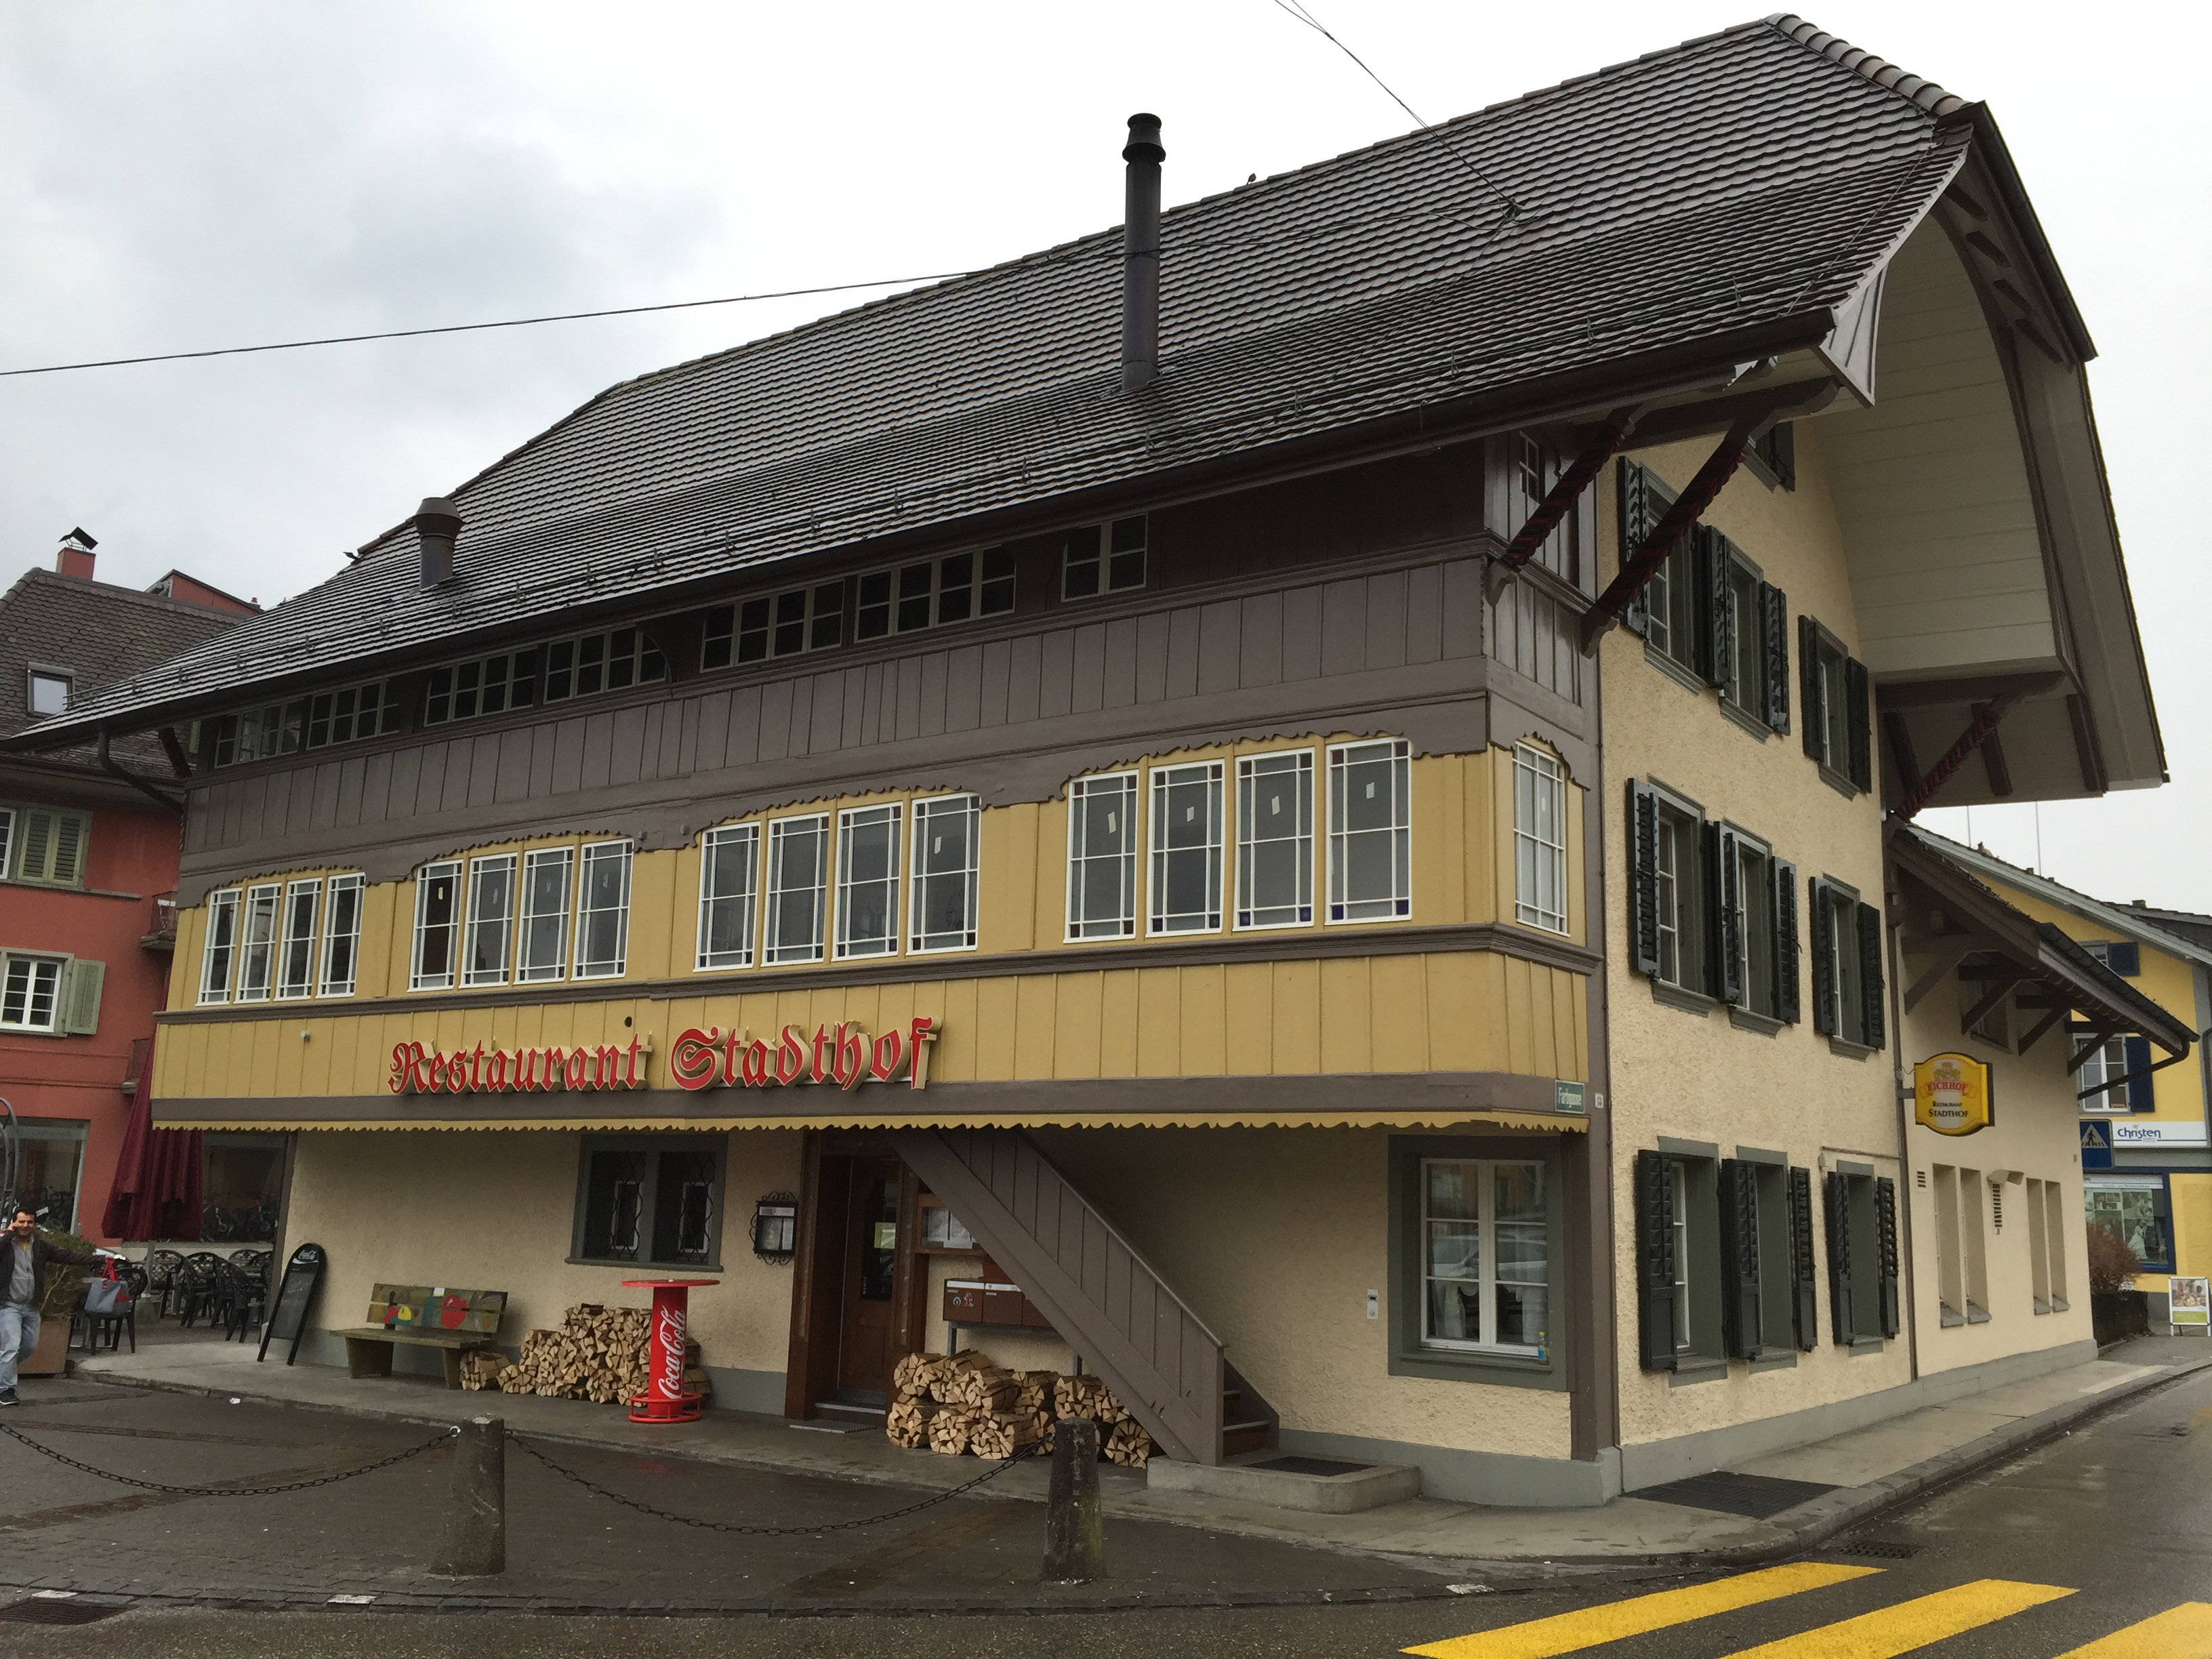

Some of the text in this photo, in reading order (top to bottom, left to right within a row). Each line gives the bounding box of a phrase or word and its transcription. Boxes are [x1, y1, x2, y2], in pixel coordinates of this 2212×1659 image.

[387, 1016, 935, 1094] Restaurant Stadthof
[1926, 1081, 1969, 1092] EICHHOF
[1928, 1109, 1969, 1118] STADTHOF
[2117, 1126, 2161, 1139] Christen
[658, 1305, 685, 1399] Coca-Cola
